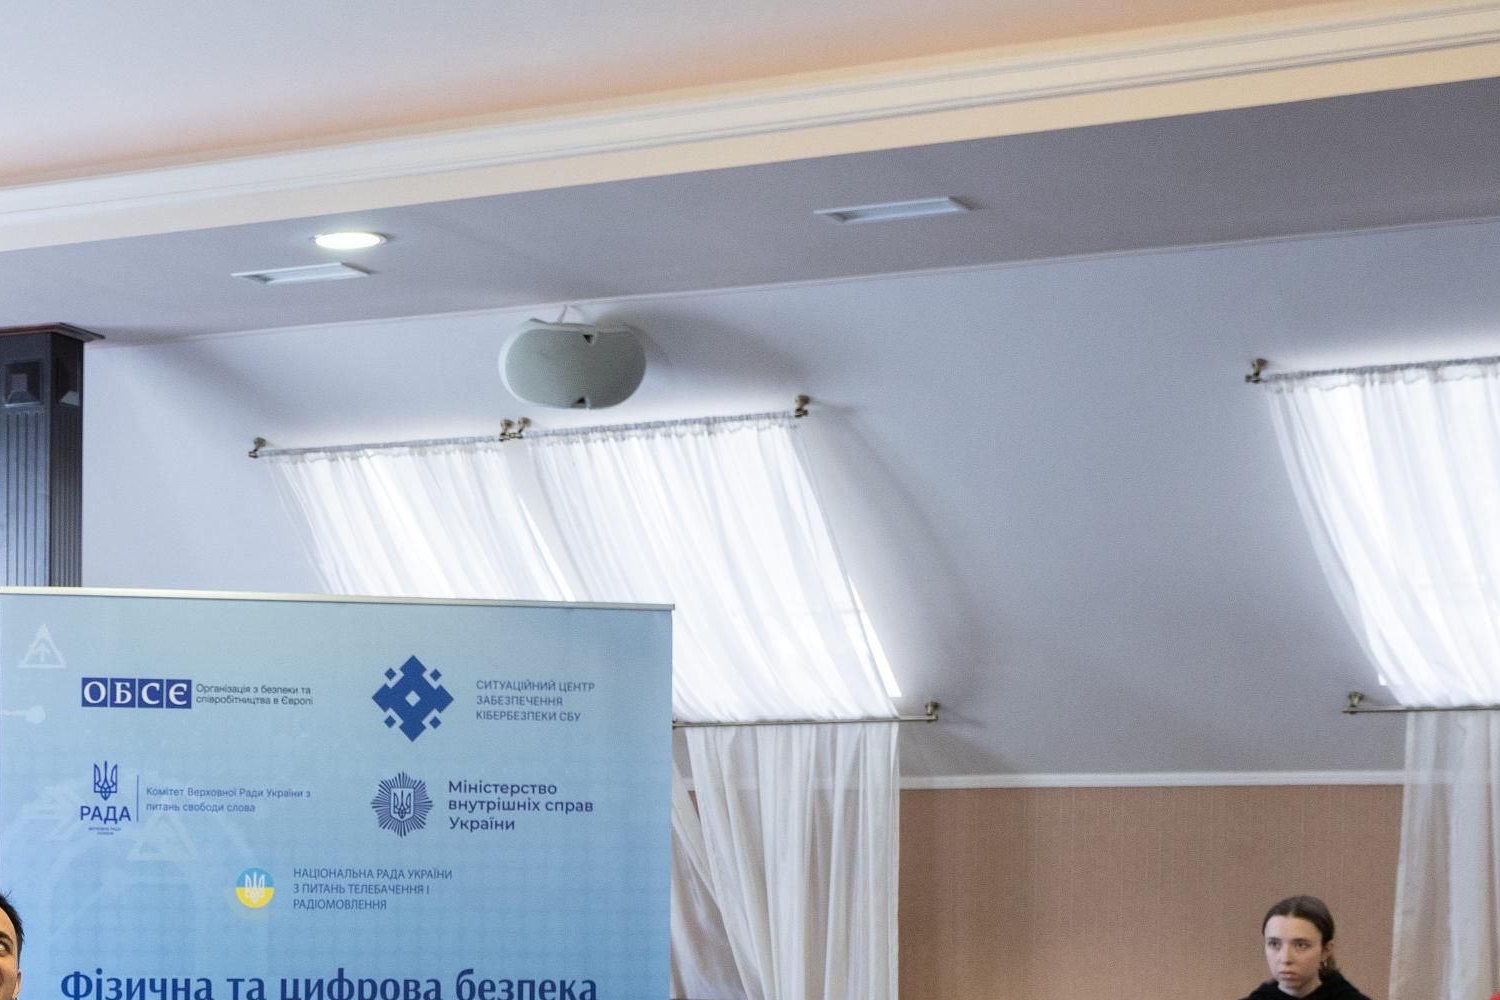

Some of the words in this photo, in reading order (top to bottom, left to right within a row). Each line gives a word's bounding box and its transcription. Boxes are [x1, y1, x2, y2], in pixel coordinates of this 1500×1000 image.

[196, 683, 250, 694] Організація
[261, 685, 298, 694] безпеки
[301, 686, 311, 694] та
[476, 679, 556, 691] СИТУАЦІЙНИЙ
[559, 682, 595, 693] ЦЕНТР
[82, 678, 191, 708] ОБСЄ
[195, 695, 271, 705] співробітництва
[476, 695, 563, 706] ЗАБЕЗПЕЧЕННЯ
[476, 710, 556, 721] КІБЕРБЕЗПЕКИ
[559, 711, 581, 722] СБУ
[146, 787, 184, 797] Комітет
[187, 786, 237, 799] Верховної
[239, 788, 263, 799] Ради
[266, 788, 303, 799] України
[448, 780, 557, 797] Міністерство
[146, 803, 180, 811] питань
[182, 802, 224, 813] свободи
[226, 804, 256, 812] слова
[448, 798, 540, 814] внутрішніх
[545, 800, 593, 815] справ
[80, 805, 131, 825] РАДА
[449, 816, 515, 832] України
[293, 868, 374, 880] НАЦІОНАЛЬНА
[376, 869, 405, 880] РАДА
[408, 867, 452, 880] УКРАЇНИ
[293, 884, 299, 894] З
[302, 884, 346, 894] ПИТАНЬ
[349, 884, 424, 895] ТЕЛЕБАЧЕННЯ
[293, 899, 387, 911] РАДІОМОВЛЕННЯ
